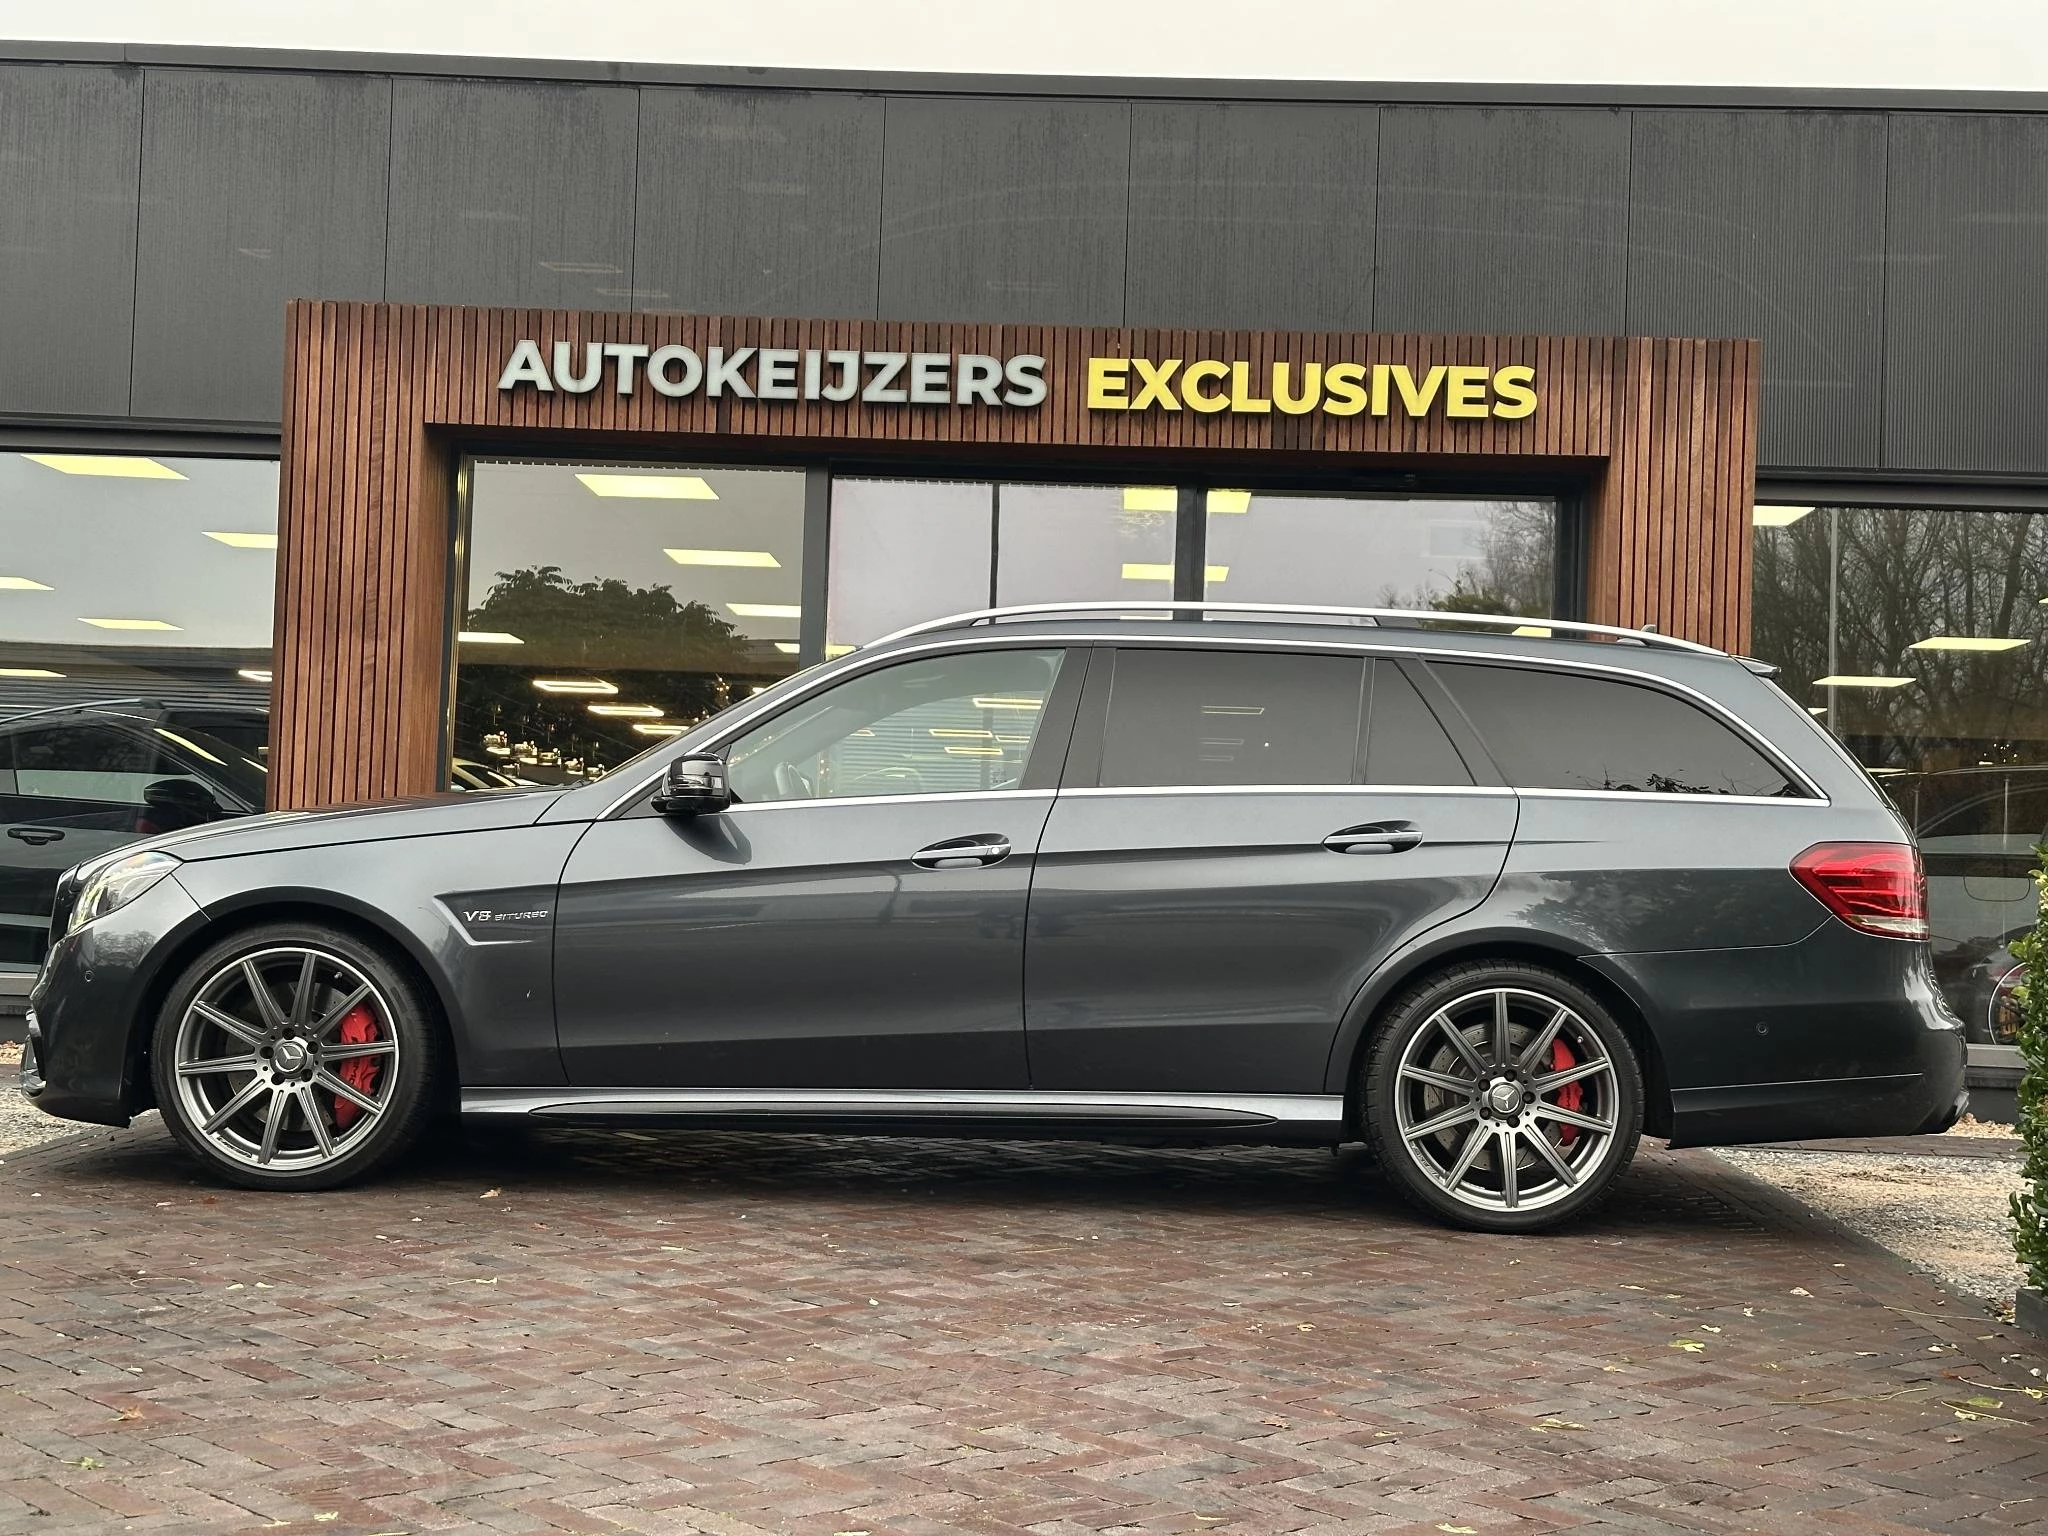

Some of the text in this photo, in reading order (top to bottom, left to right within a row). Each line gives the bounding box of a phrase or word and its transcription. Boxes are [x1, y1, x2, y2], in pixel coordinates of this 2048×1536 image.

[496, 339, 1539, 420] AUTOKEIJZERS EXCLUSIVES
[463, 910, 549, 922] V8 BITURBO
